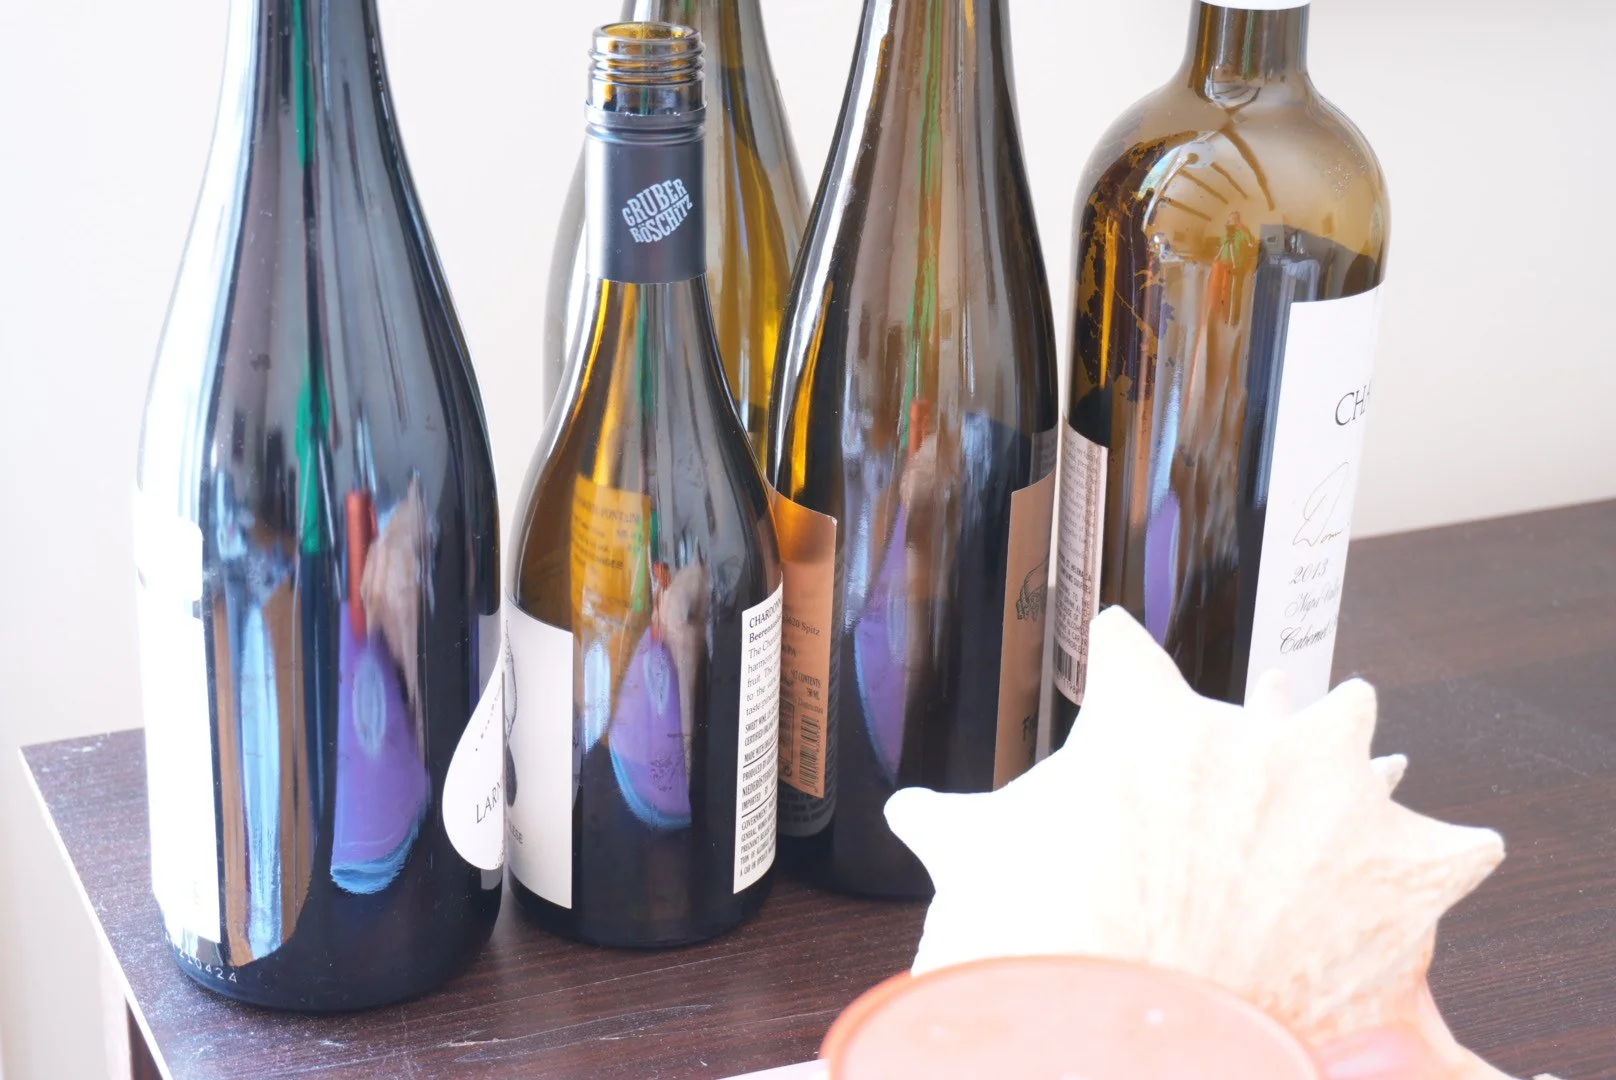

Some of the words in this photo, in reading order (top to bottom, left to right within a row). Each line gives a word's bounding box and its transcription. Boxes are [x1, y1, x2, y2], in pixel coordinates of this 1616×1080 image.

[622, 178, 687, 226] GRUBER
[1289, 558, 1329, 584] 2013
[801, 622, 820, 636] Spitz
[747, 647, 762, 659] The
[798, 671, 821, 688] CONTENTS
